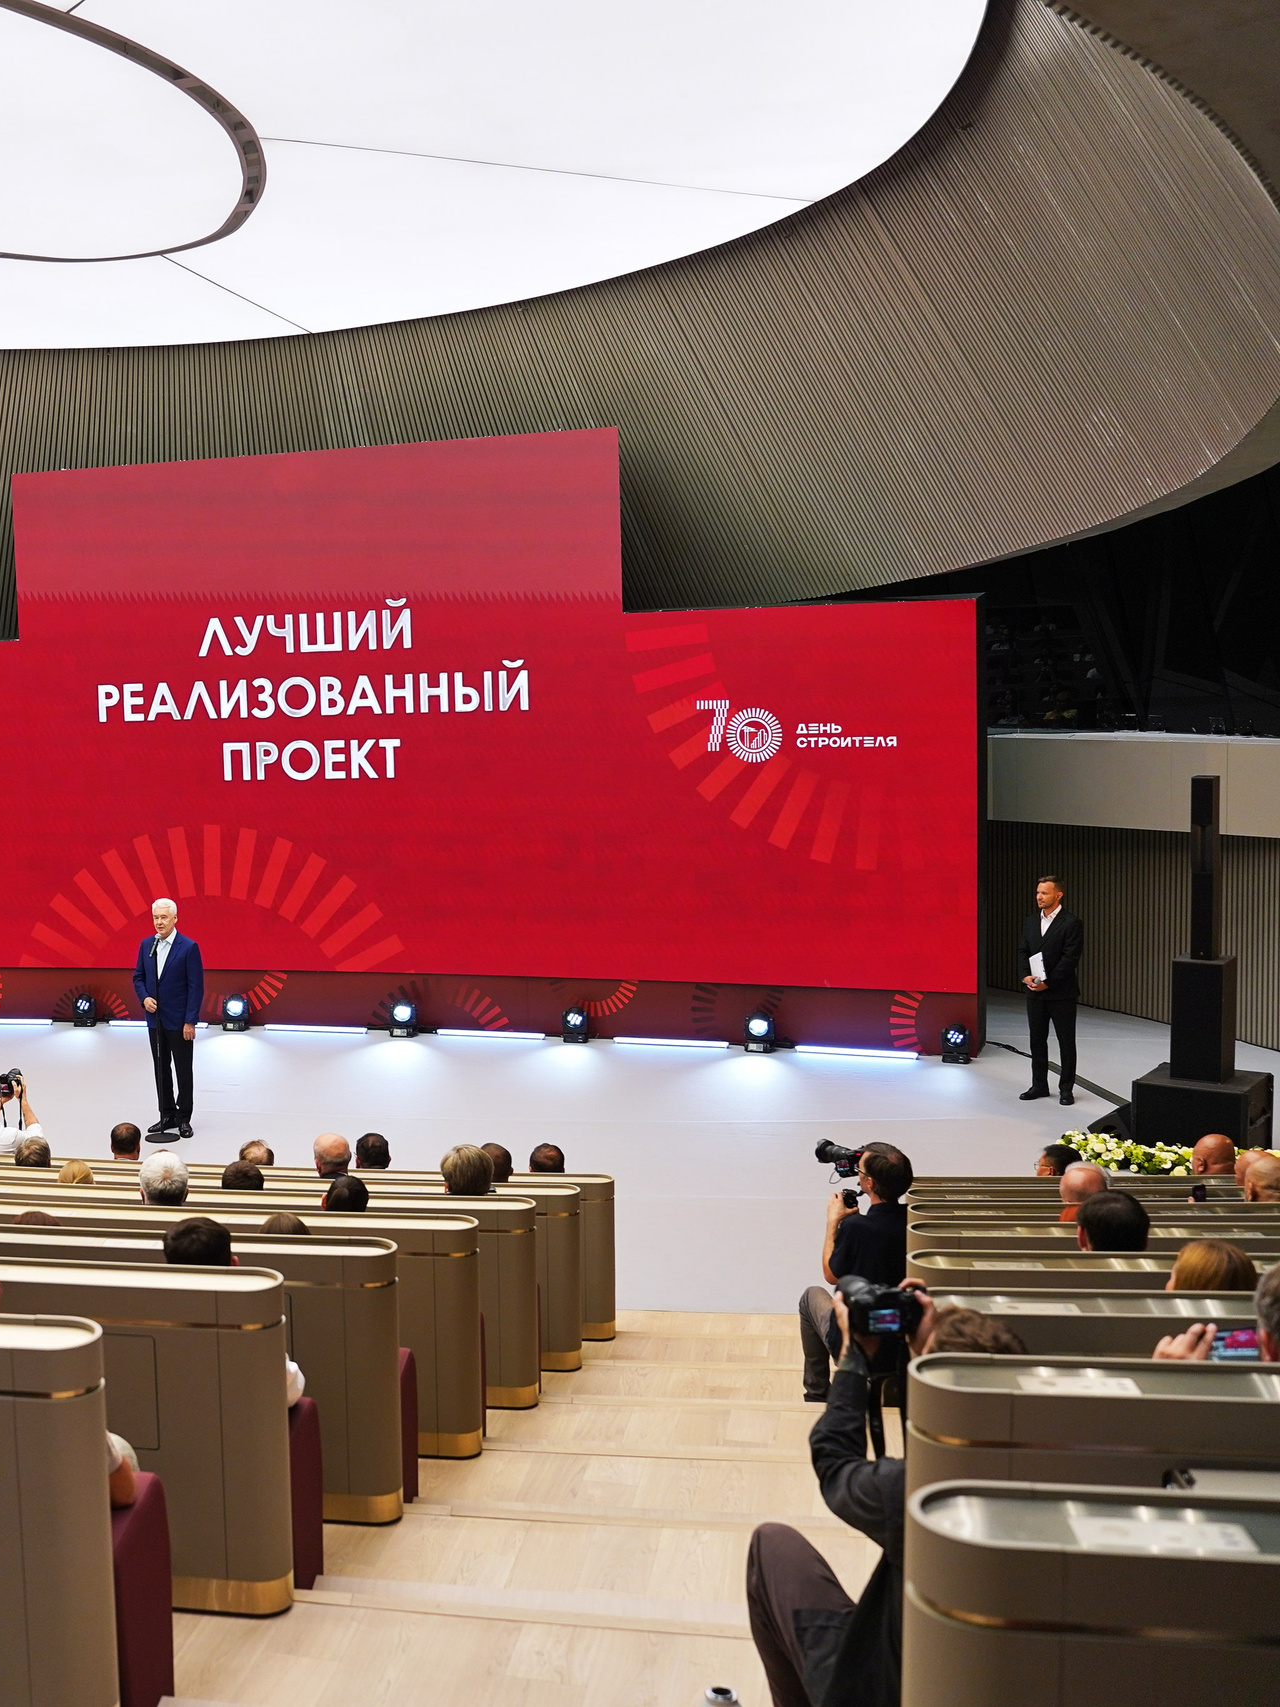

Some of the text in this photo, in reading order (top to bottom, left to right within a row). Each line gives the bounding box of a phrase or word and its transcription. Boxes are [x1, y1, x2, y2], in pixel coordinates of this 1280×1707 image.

[198, 597, 412, 657] ЛУЧШИЙ
[97, 659, 530, 723] РЕАЛИЗОВАННЫЙ
[795, 723, 843, 735] ДЕНЬ
[796, 736, 898, 748] СТРОИТЕЛЯ
[222, 738, 402, 782] ПРОЕКТ
